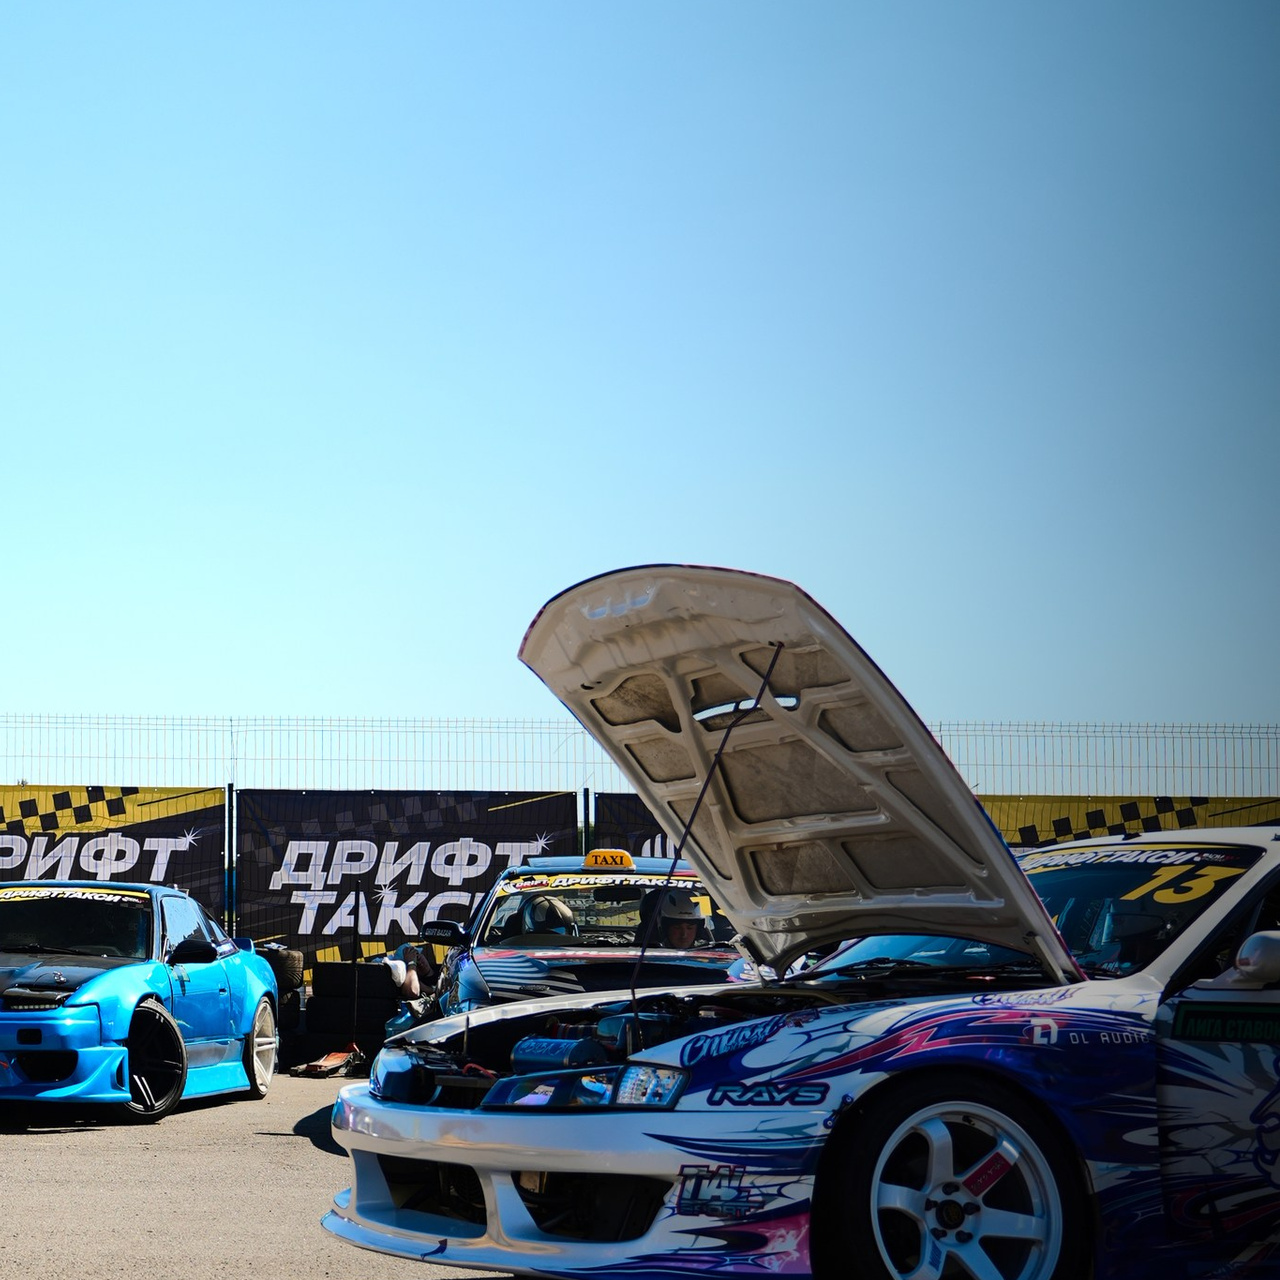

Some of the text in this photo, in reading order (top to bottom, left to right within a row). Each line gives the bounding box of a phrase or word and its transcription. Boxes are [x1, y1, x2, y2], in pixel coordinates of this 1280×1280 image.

[269, 837, 542, 890] ДРИФТ
[592, 855, 624, 865] TAXI
[516, 879, 548, 888] DRIFT
[1120, 864, 1248, 904] 13
[290, 891, 486, 935] ТАКС
[1185, 1017, 1222, 1038] ЛИГА
[1069, 1032, 1089, 1044] DL
[709, 1084, 827, 1104] RAYS
